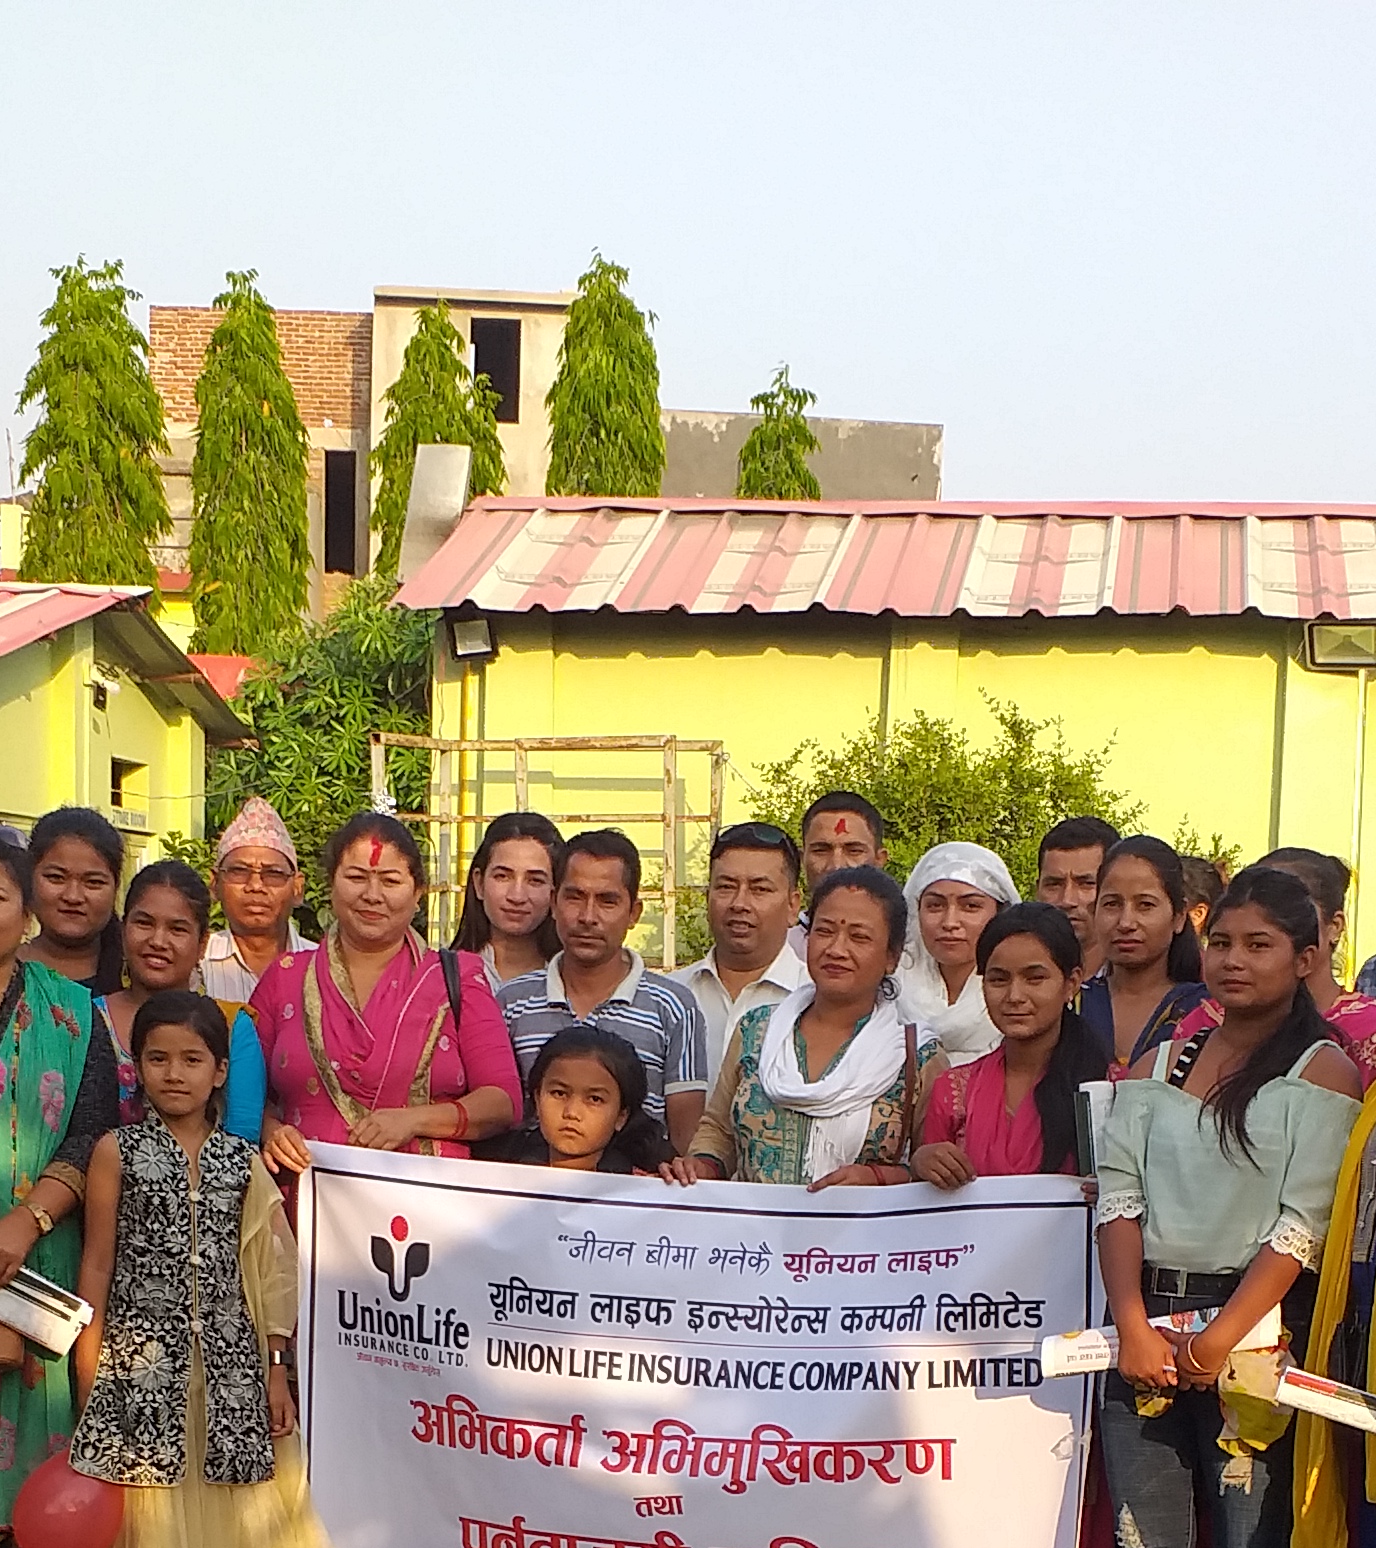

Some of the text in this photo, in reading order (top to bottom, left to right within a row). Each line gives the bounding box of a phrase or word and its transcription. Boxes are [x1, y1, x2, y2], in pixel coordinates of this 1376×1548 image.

[646, 1236, 699, 1271] बीमा
[783, 1247, 880, 1283] यूनियन
[337, 1289, 470, 1350] UnionLife
[488, 1276, 1046, 1334] यूनियन लाइफ इन्स्योरेन्स कम्पनी लिमिटेड
[338, 1332, 409, 1357] INSURANCE
[438, 1350, 468, 1368] LTD.
[486, 1337, 1044, 1391] UNION LIFE INSURANCE COMPANY LIMITED
[410, 1393, 957, 1495] अभिकर्ता अभिमुखिकरण
[633, 1495, 684, 1517] तथा
